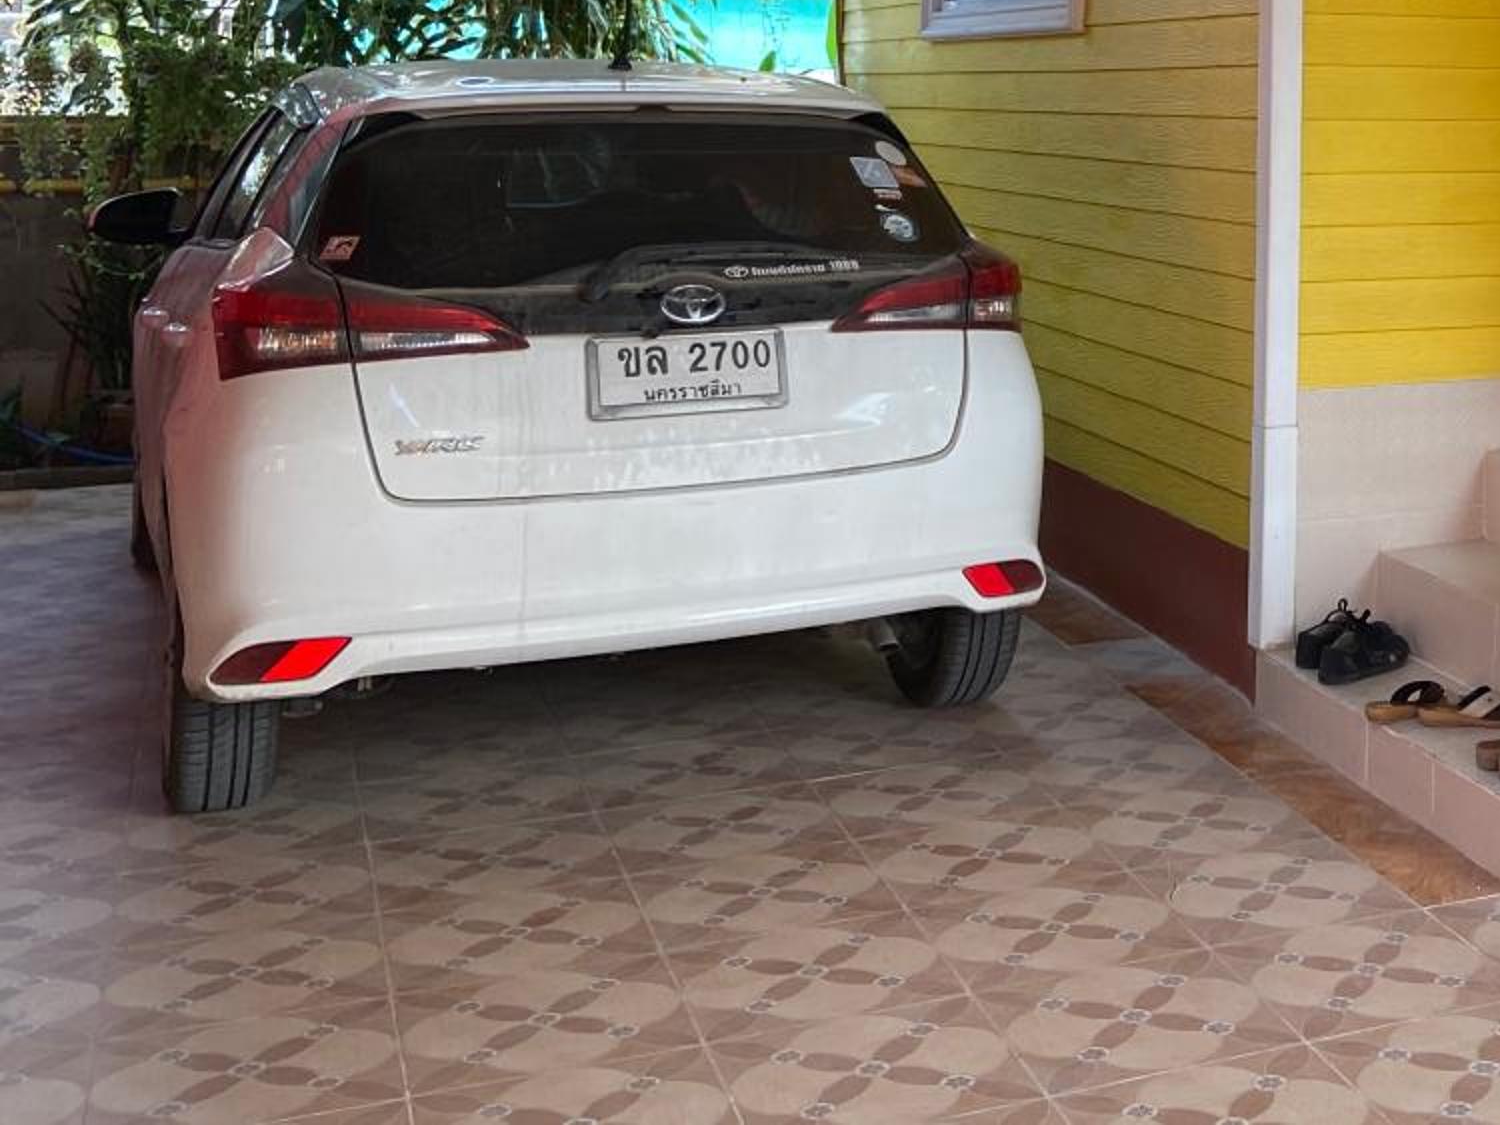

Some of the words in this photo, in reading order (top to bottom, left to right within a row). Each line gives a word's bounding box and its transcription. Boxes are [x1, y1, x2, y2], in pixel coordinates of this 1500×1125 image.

[617, 346, 669, 377] ขล
[688, 339, 771, 373] 2700
[643, 378, 742, 401] นครราชสีมา
